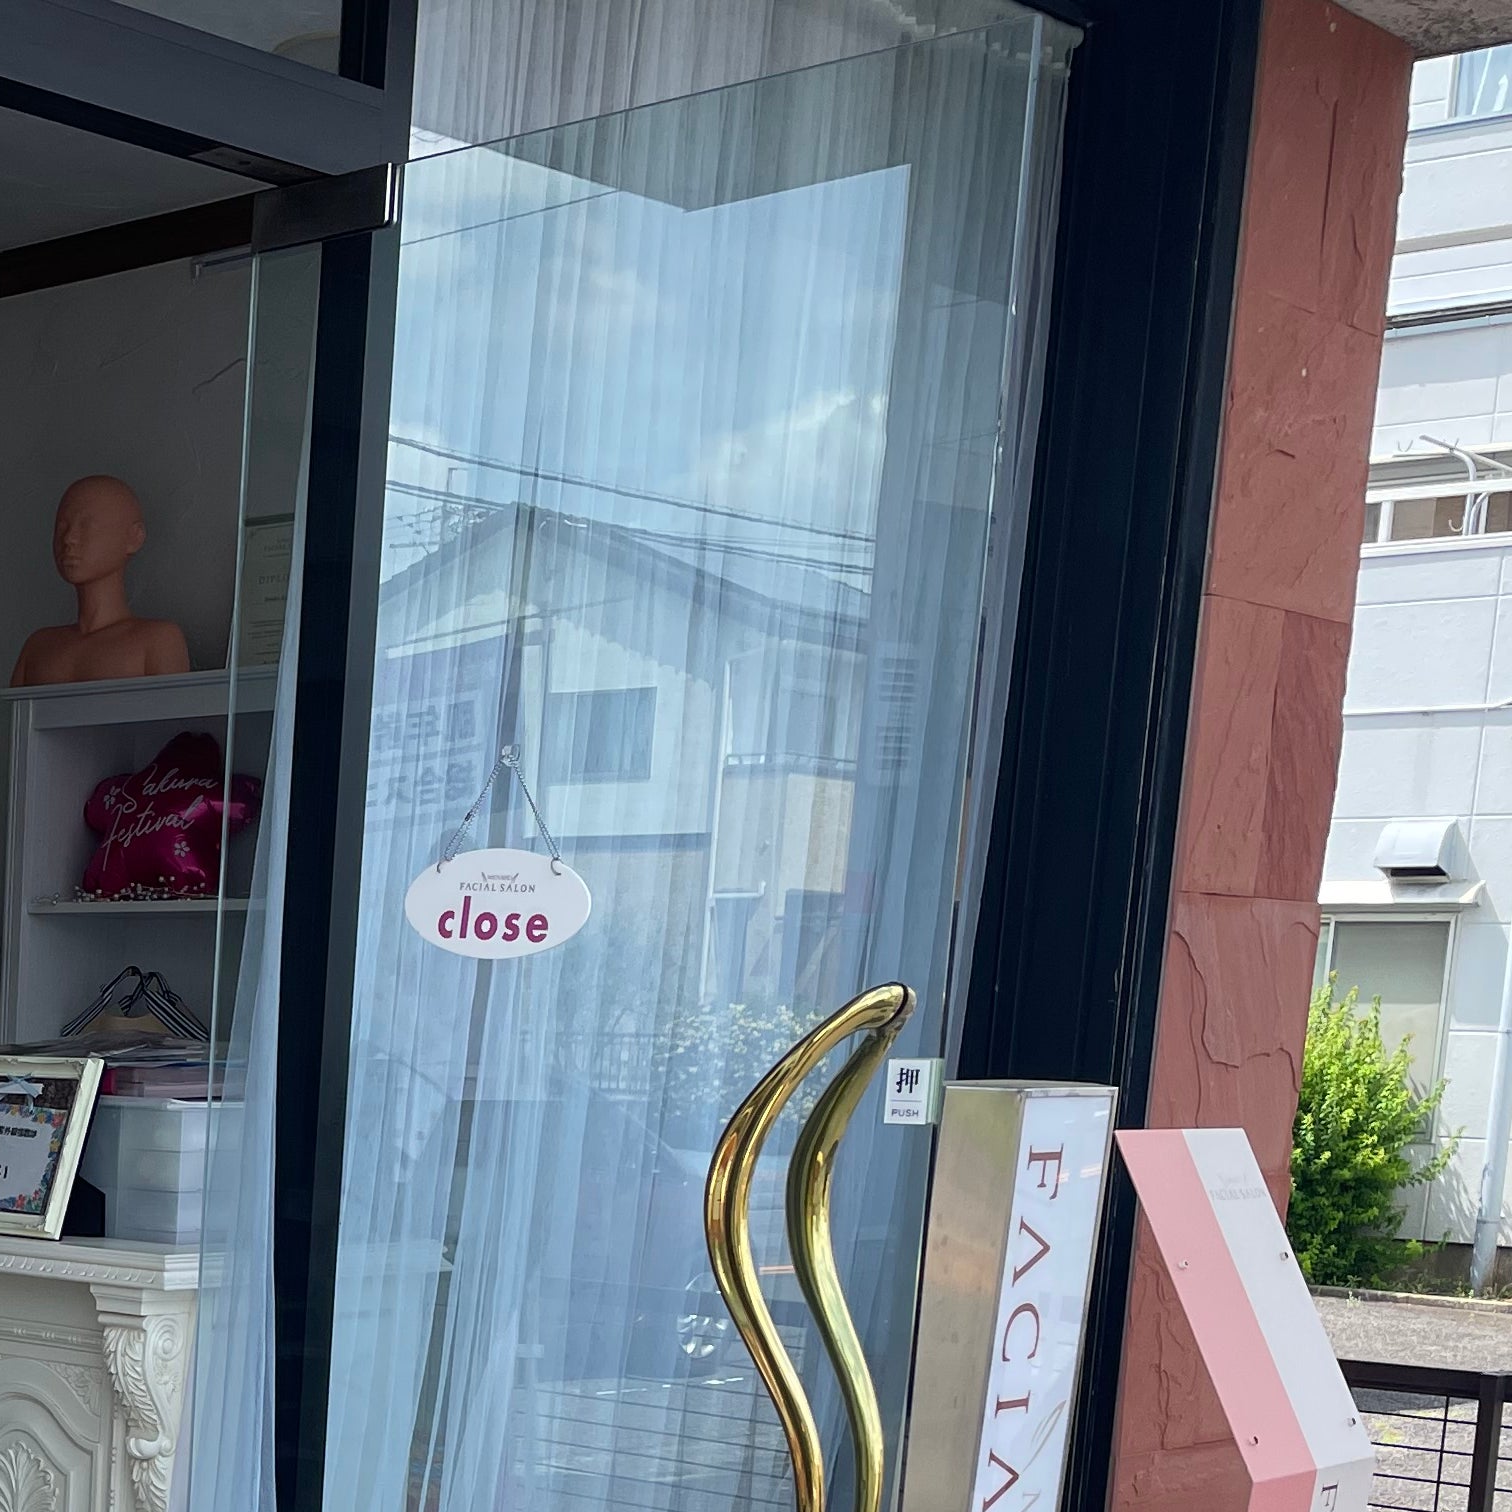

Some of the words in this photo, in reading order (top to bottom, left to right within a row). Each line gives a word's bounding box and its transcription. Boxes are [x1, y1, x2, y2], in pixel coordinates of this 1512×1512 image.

[122, 763, 218, 814] Sakura
[459, 882, 497, 892] FACIAL
[500, 883, 536, 893] SALON
[438, 895, 549, 943] close
[896, 1067, 920, 1094] 押
[891, 1108, 919, 1117] PUSH
